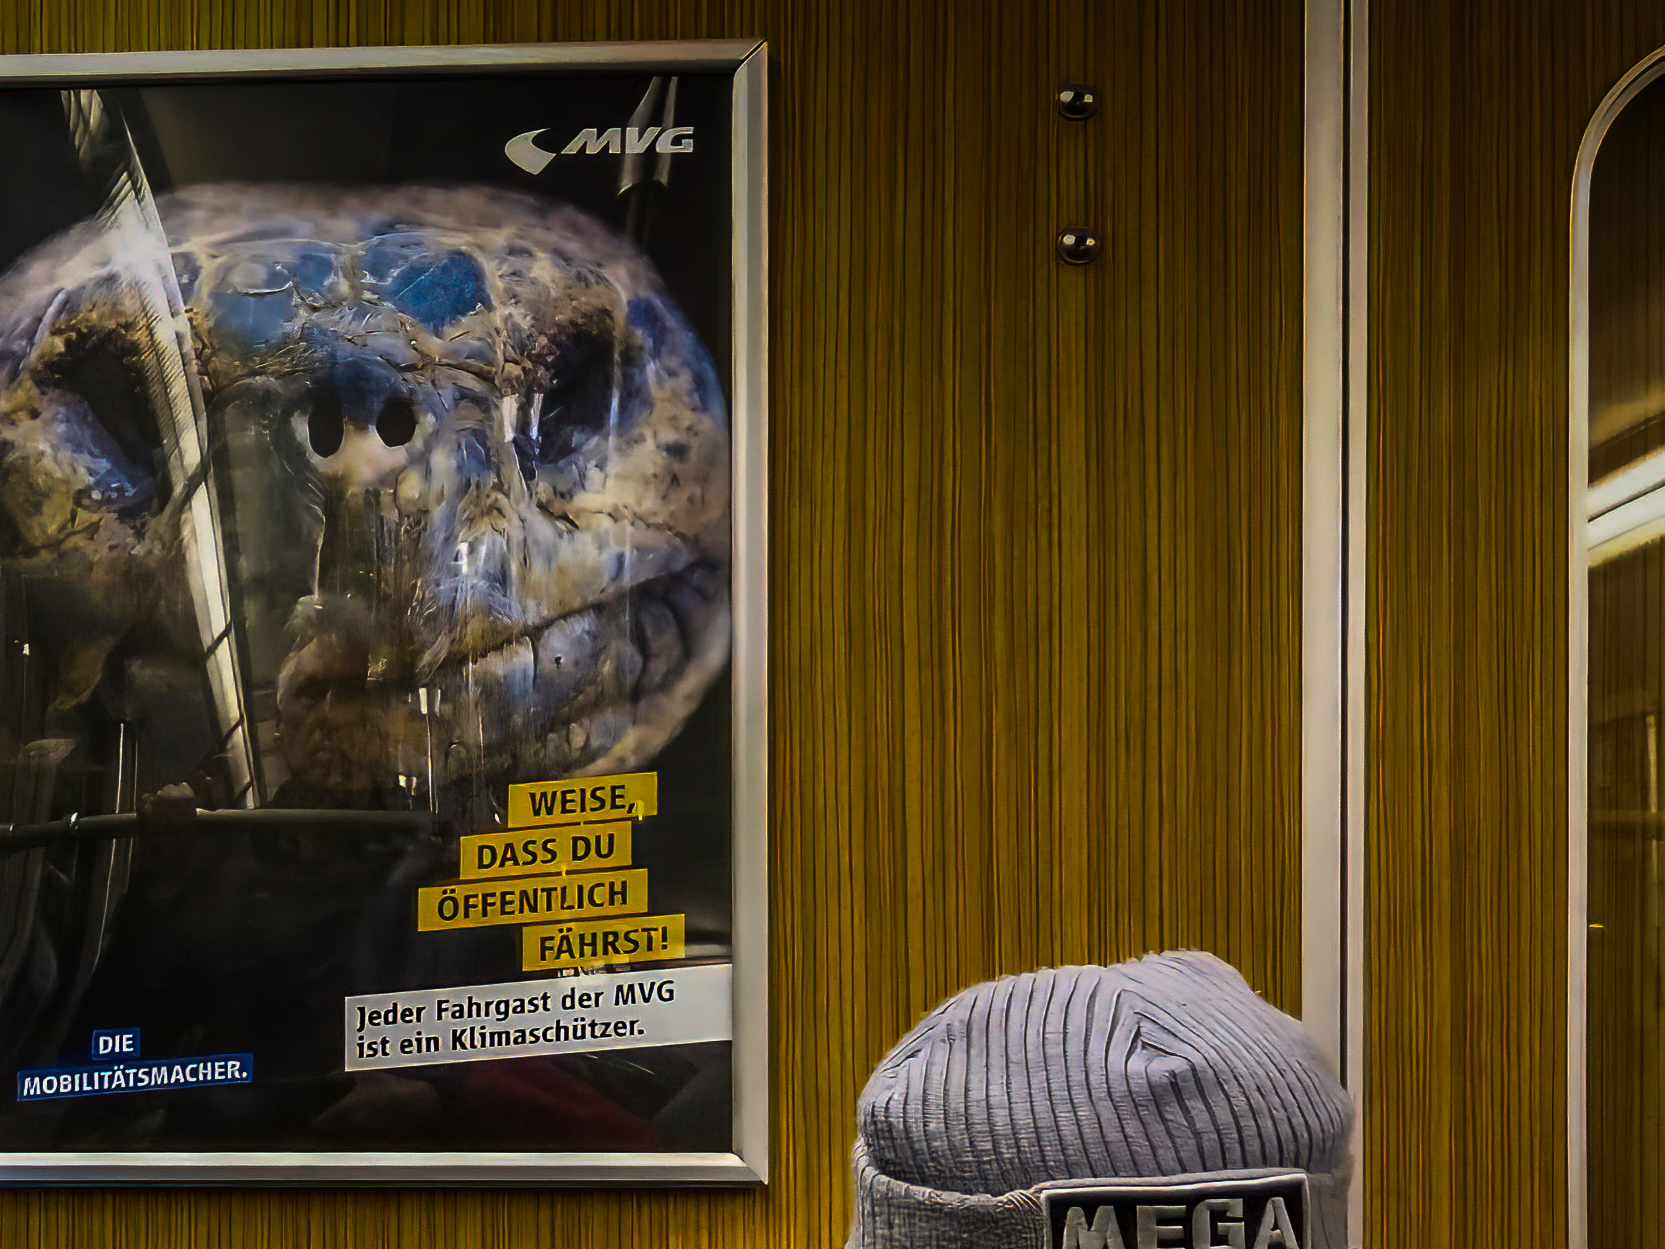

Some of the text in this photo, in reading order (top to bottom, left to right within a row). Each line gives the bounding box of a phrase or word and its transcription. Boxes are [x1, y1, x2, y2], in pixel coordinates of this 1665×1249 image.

[560, 126, 695, 155] MVG
[528, 783, 637, 816] WEISE,
[476, 832, 616, 871] DASS DU
[436, 879, 629, 922] ÖFFENTLICH
[538, 925, 670, 962] FÄHRST!
[356, 979, 676, 1033] Jeder Fahrgast der MVG
[98, 1034, 134, 1054] DIE
[356, 1015, 645, 1060] ist ein Klimaschützer.
[22, 1060, 248, 1096] MOBILITÄTSMACHER.
